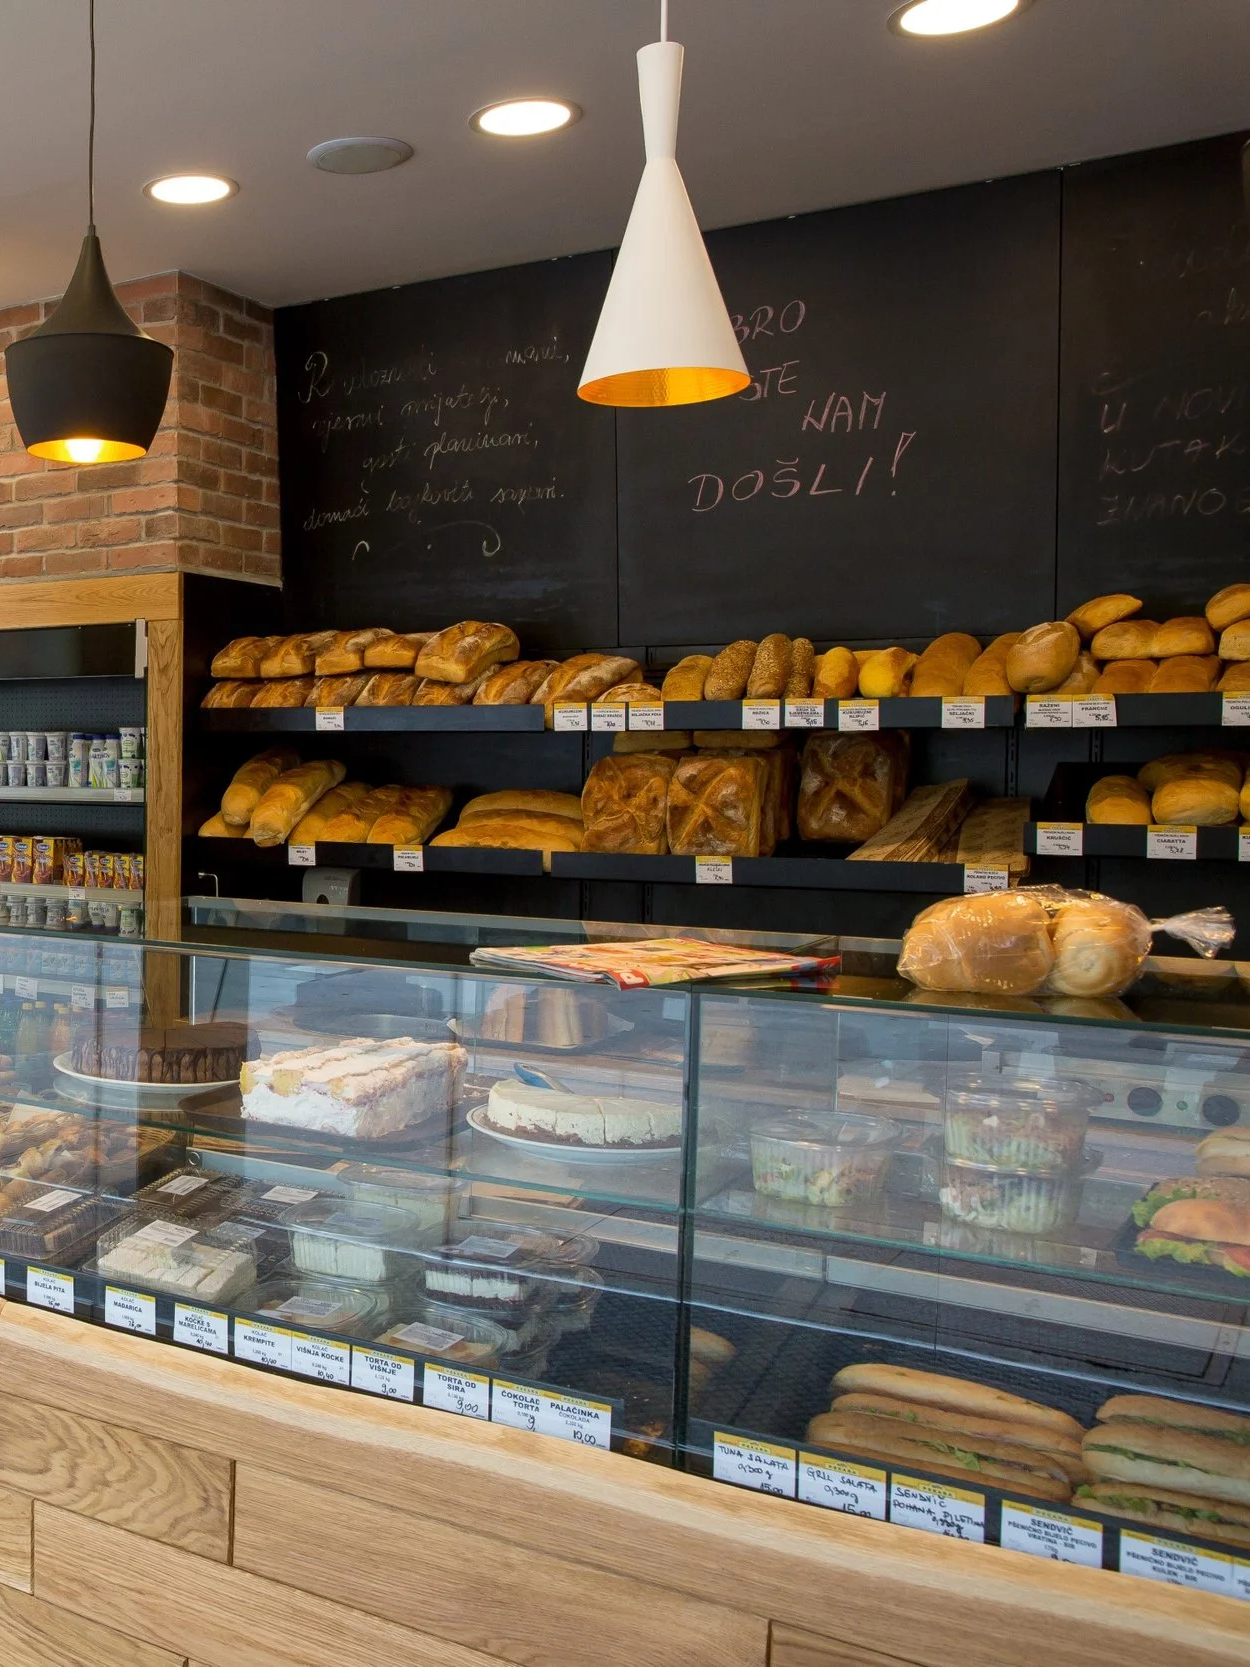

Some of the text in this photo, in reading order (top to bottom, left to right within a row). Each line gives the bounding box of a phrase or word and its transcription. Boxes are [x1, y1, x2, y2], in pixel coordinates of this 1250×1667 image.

[729, 300, 806, 344] BRO
[801, 391, 887, 433] NAM
[34, 1281, 52, 1290] BIJELA
[179, 1321, 217, 1334] MARELICAMA
[244, 1334, 275, 1347] KREMPITE
[296, 1346, 344, 1362] VIŠNJA KOCKE
[364, 1356, 389, 1366] TORTA
[318, 1370, 334, 1380] 10,40
[369, 1364, 396, 1375] VIŠNJE
[438, 1374, 462, 1385] TORTA
[382, 1383, 397, 1396] 9,00
[447, 1384, 465, 1393] SIRA
[456, 1400, 478, 1414] 9,00
[513, 1401, 540, 1412] TORTA
[550, 1402, 600, 1420] PALAČINKA
[559, 1411, 590, 1423] ČOKOLADA
[573, 1430, 596, 1445] 10,00
[718, 1445, 789, 1470] TUNA SALATA
[840, 1476, 877, 1493] SALATA
[1030, 1518, 1073, 1535] SENDVIČ
[1008, 1520, 1097, 1549] PŠENIČNO BIJELO PECIVO
[1152, 1548, 1198, 1566] SENDVIČ
[1126, 1551, 1226, 1582] PŠENIČNO BIJELO PECIVO
[1152, 1566, 1178, 1577] KULEN
[1185, 1574, 1198, 1582] SIR
